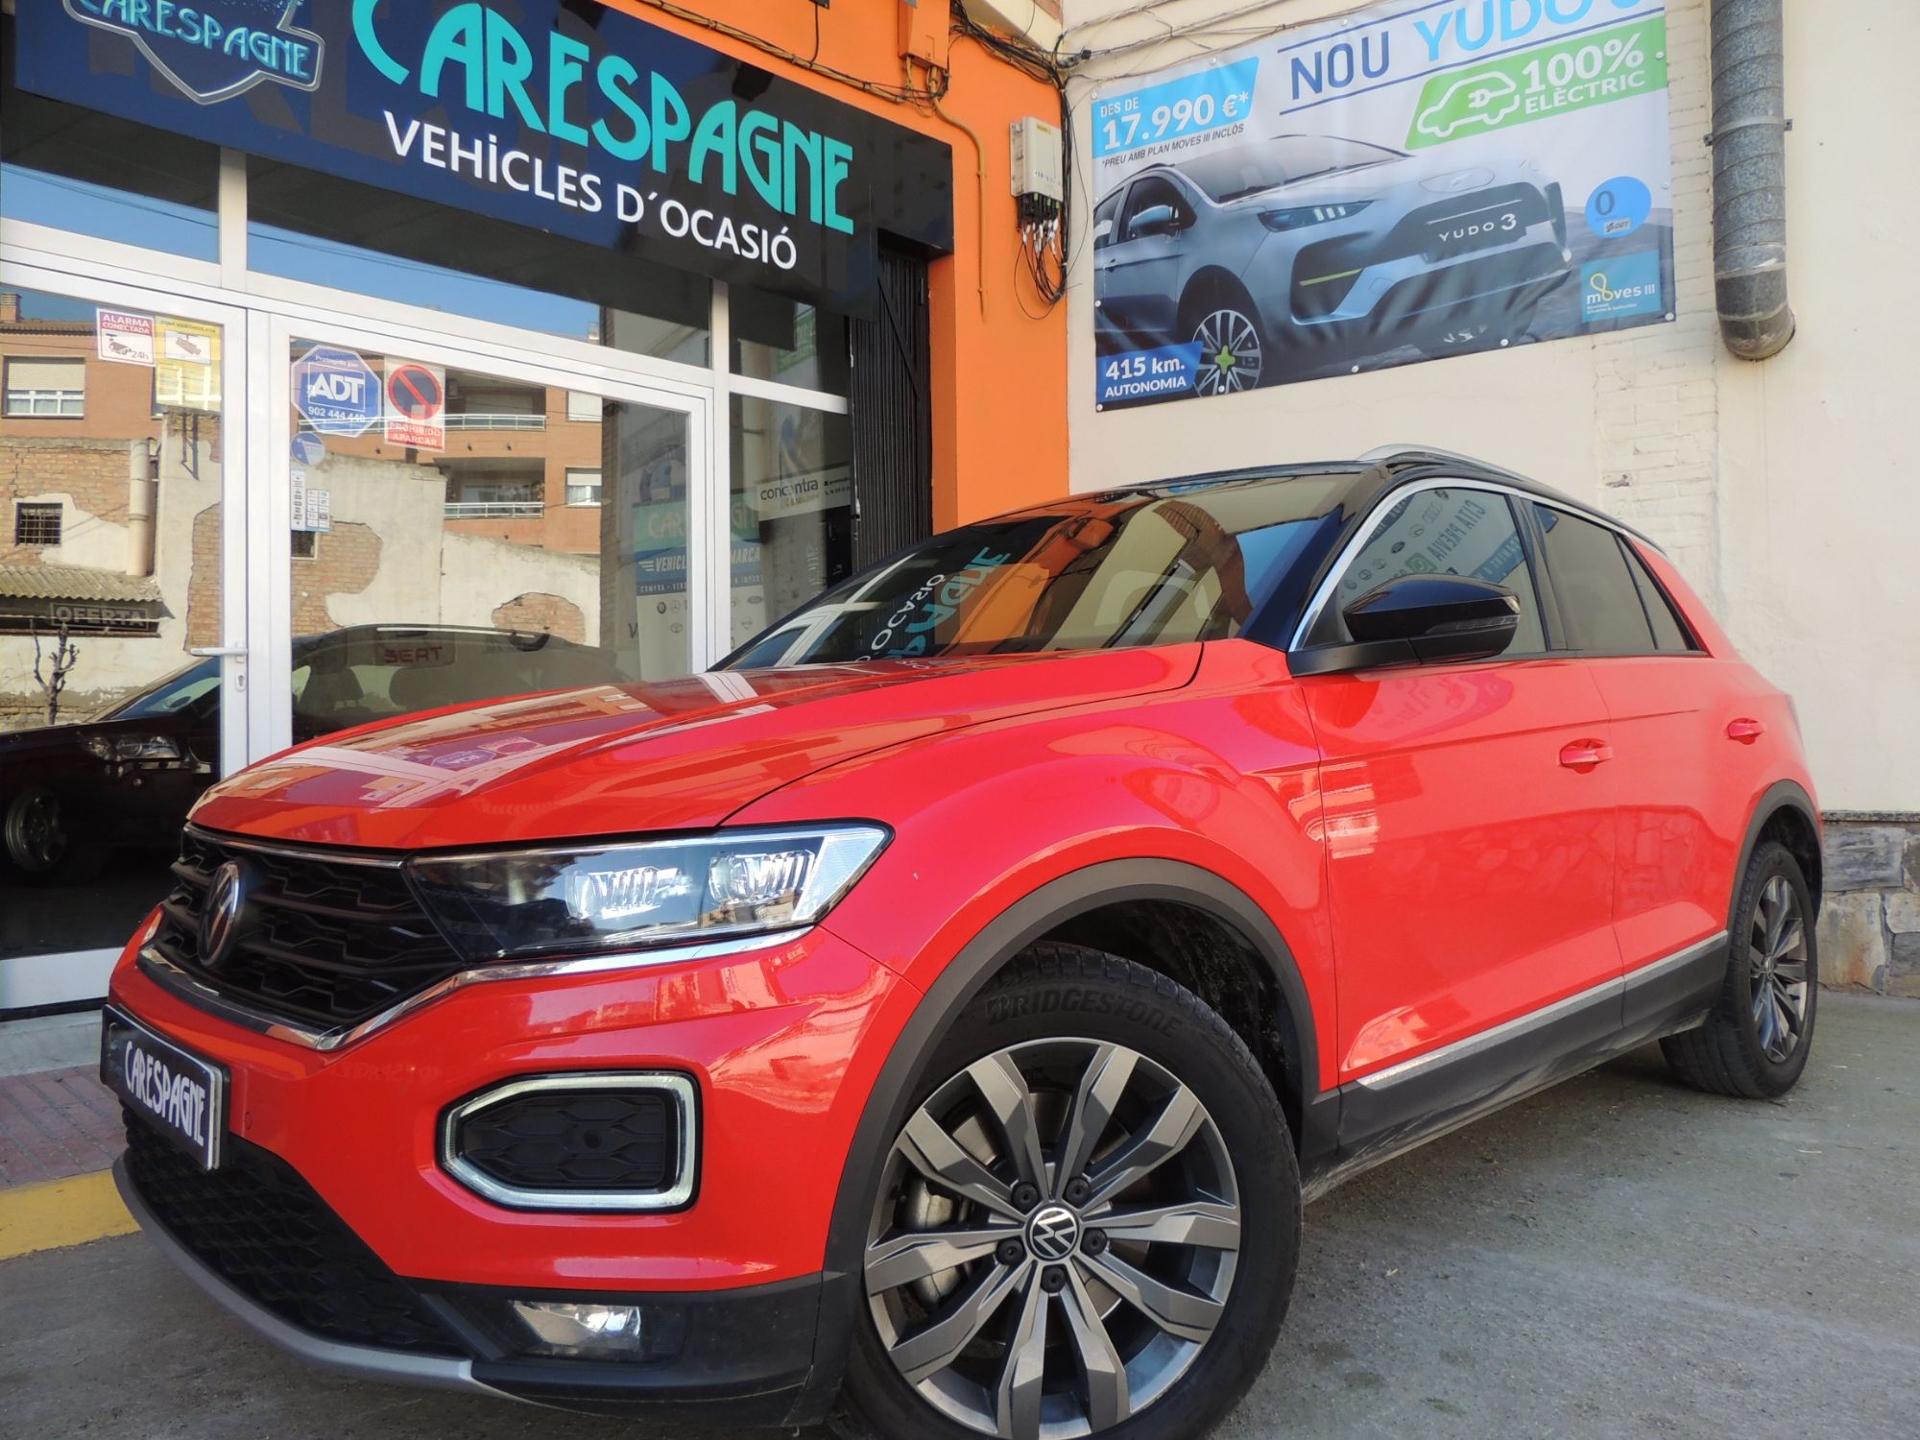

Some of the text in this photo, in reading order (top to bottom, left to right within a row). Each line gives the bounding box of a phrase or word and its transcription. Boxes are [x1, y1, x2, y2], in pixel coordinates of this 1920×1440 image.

[1291, 0, 1595, 100] NOU YUDO
[1521, 32, 1645, 94] 100%
[1525, 70, 1646, 114] ELÈCTRIC
[352, 0, 854, 235] CARESPAGNE
[1101, 97, 1140, 117] DES DE
[1102, 94, 1215, 151] 17.990
[1128, 149, 1146, 163] AMB
[1148, 143, 1170, 159] PLAN
[1171, 135, 1202, 153] MOVES
[1438, 213, 1517, 243] YUDO 3
[102, 314, 150, 328] ALARMA
[102, 321, 150, 335] CONECTADA
[131, 350, 149, 361] 24h
[1105, 356, 1186, 380] 415 km.
[312, 372, 365, 404] ADT
[1105, 375, 1187, 398] AUTONOMIA
[308, 406, 327, 417] 902
[389, 421, 442, 437] PROHIBIDO
[392, 433, 438, 446] APARCAR
[55, 605, 146, 628] OFERTA
[384, 647, 443, 664] SEAT
[985, 987, 1184, 1039] BRIDGESTONE
[125, 1041, 206, 1147] CARESPAGNE
